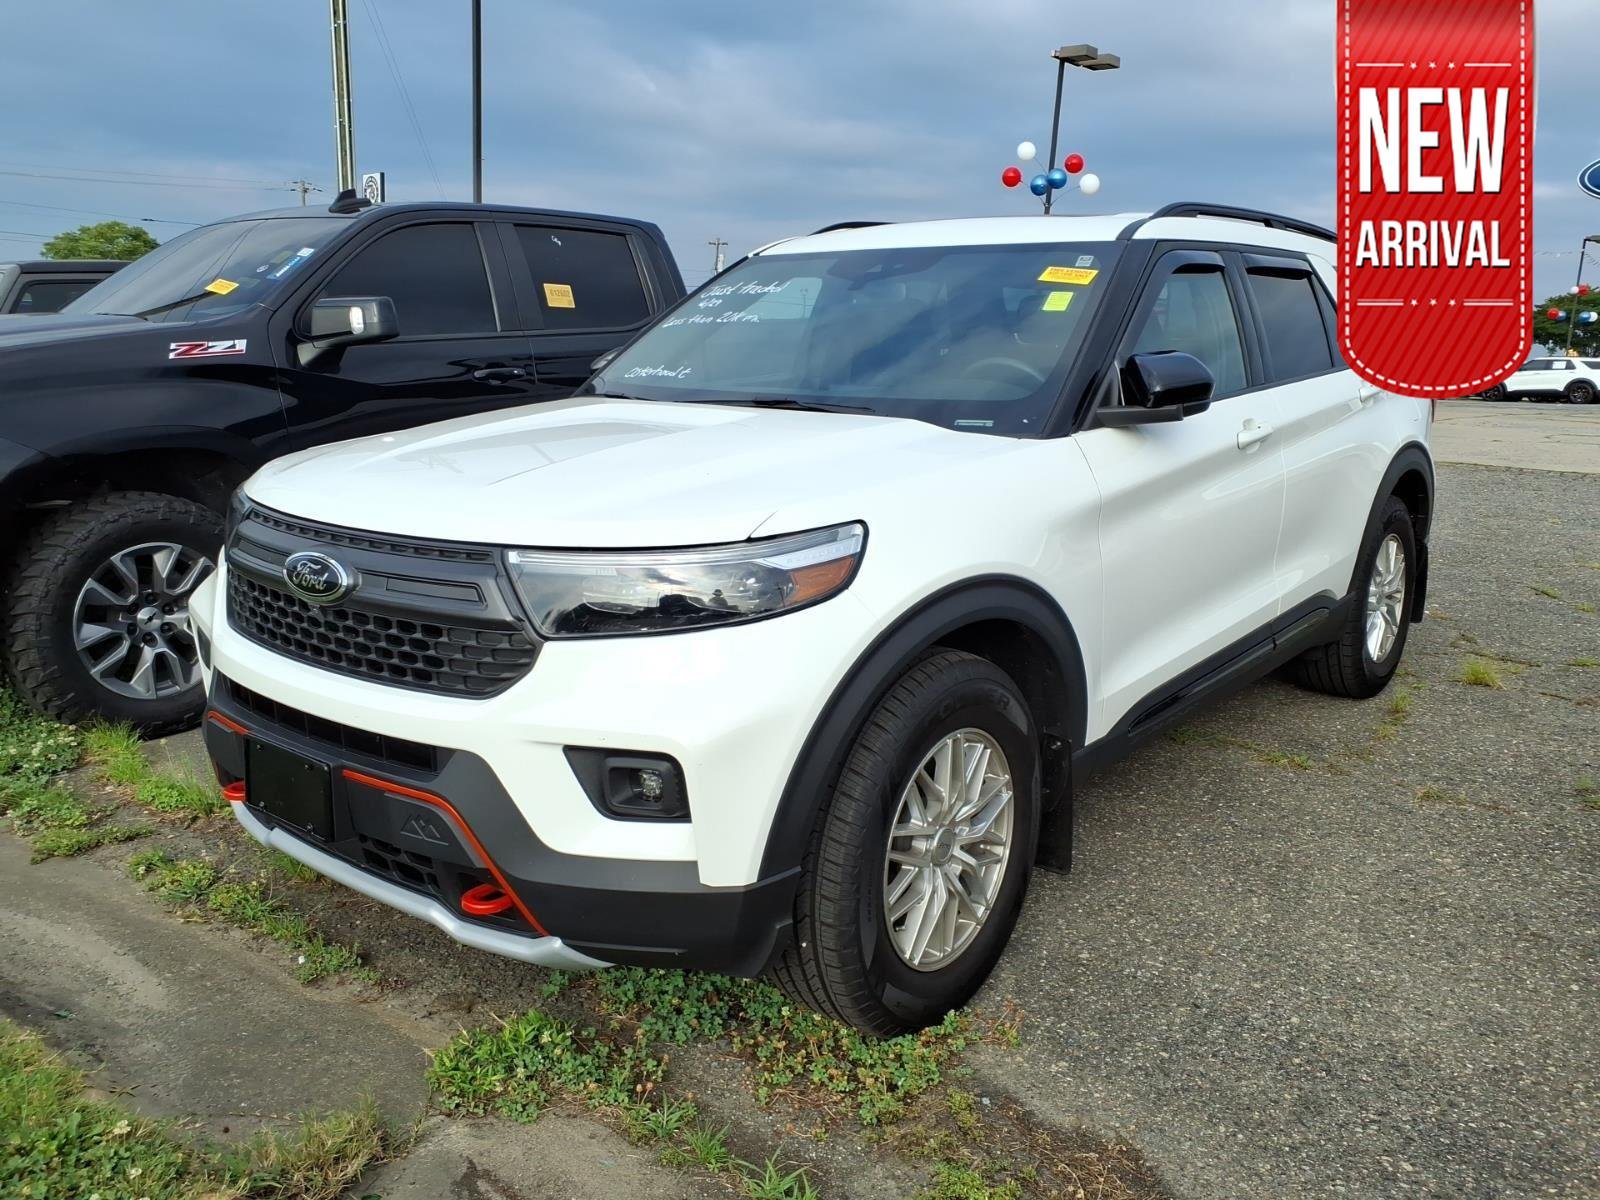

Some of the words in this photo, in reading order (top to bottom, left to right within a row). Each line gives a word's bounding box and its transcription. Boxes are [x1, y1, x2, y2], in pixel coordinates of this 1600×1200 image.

[738, 281, 791, 295] traded
[168, 339, 247, 359] Z71
[293, 560, 329, 590] Ford
